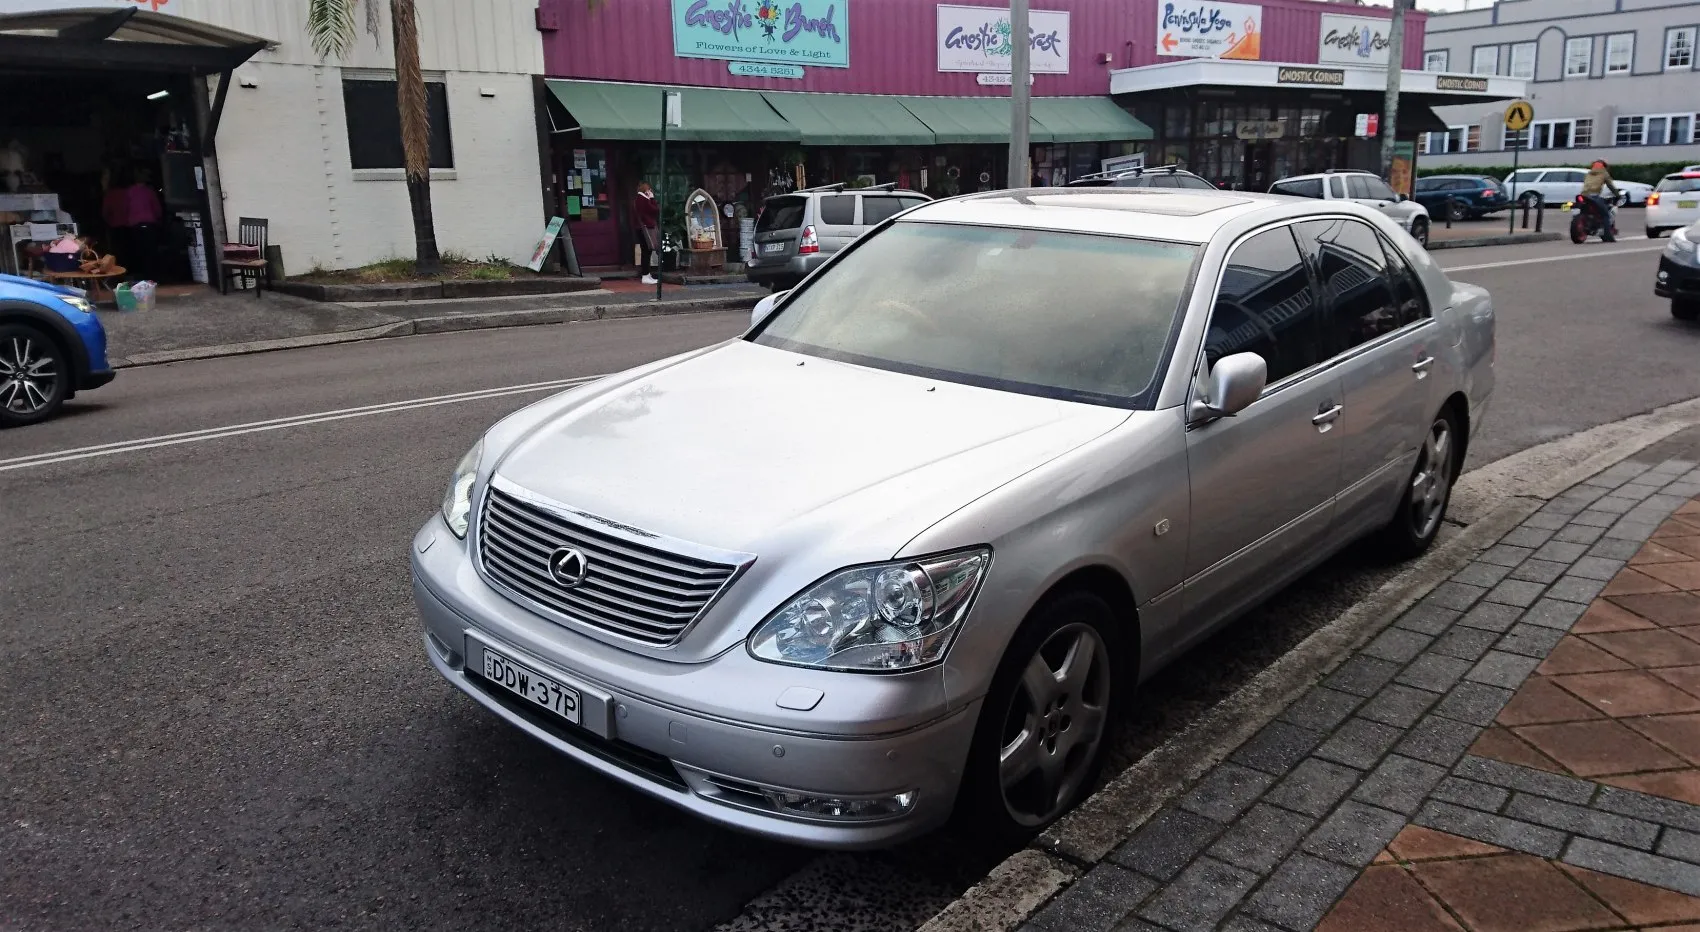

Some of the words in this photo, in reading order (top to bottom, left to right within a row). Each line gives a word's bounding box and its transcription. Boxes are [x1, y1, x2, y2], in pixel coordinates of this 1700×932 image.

[1162, 2, 1207, 33] Peninsula
[1199, 8, 1232, 34] Yoga
[944, 22, 998, 58] Gnostic
[1324, 25, 1361, 51] Gnostic
[695, 41, 744, 54] Flowers
[745, 46, 757, 54] of
[759, 47, 787, 56] Love
[789, 48, 800, 57] &
[801, 49, 832, 60] Light
[738, 65, 768, 75] 4344
[1279, 68, 1312, 82] GNOSTIC
[1313, 69, 1344, 84] CORNER
